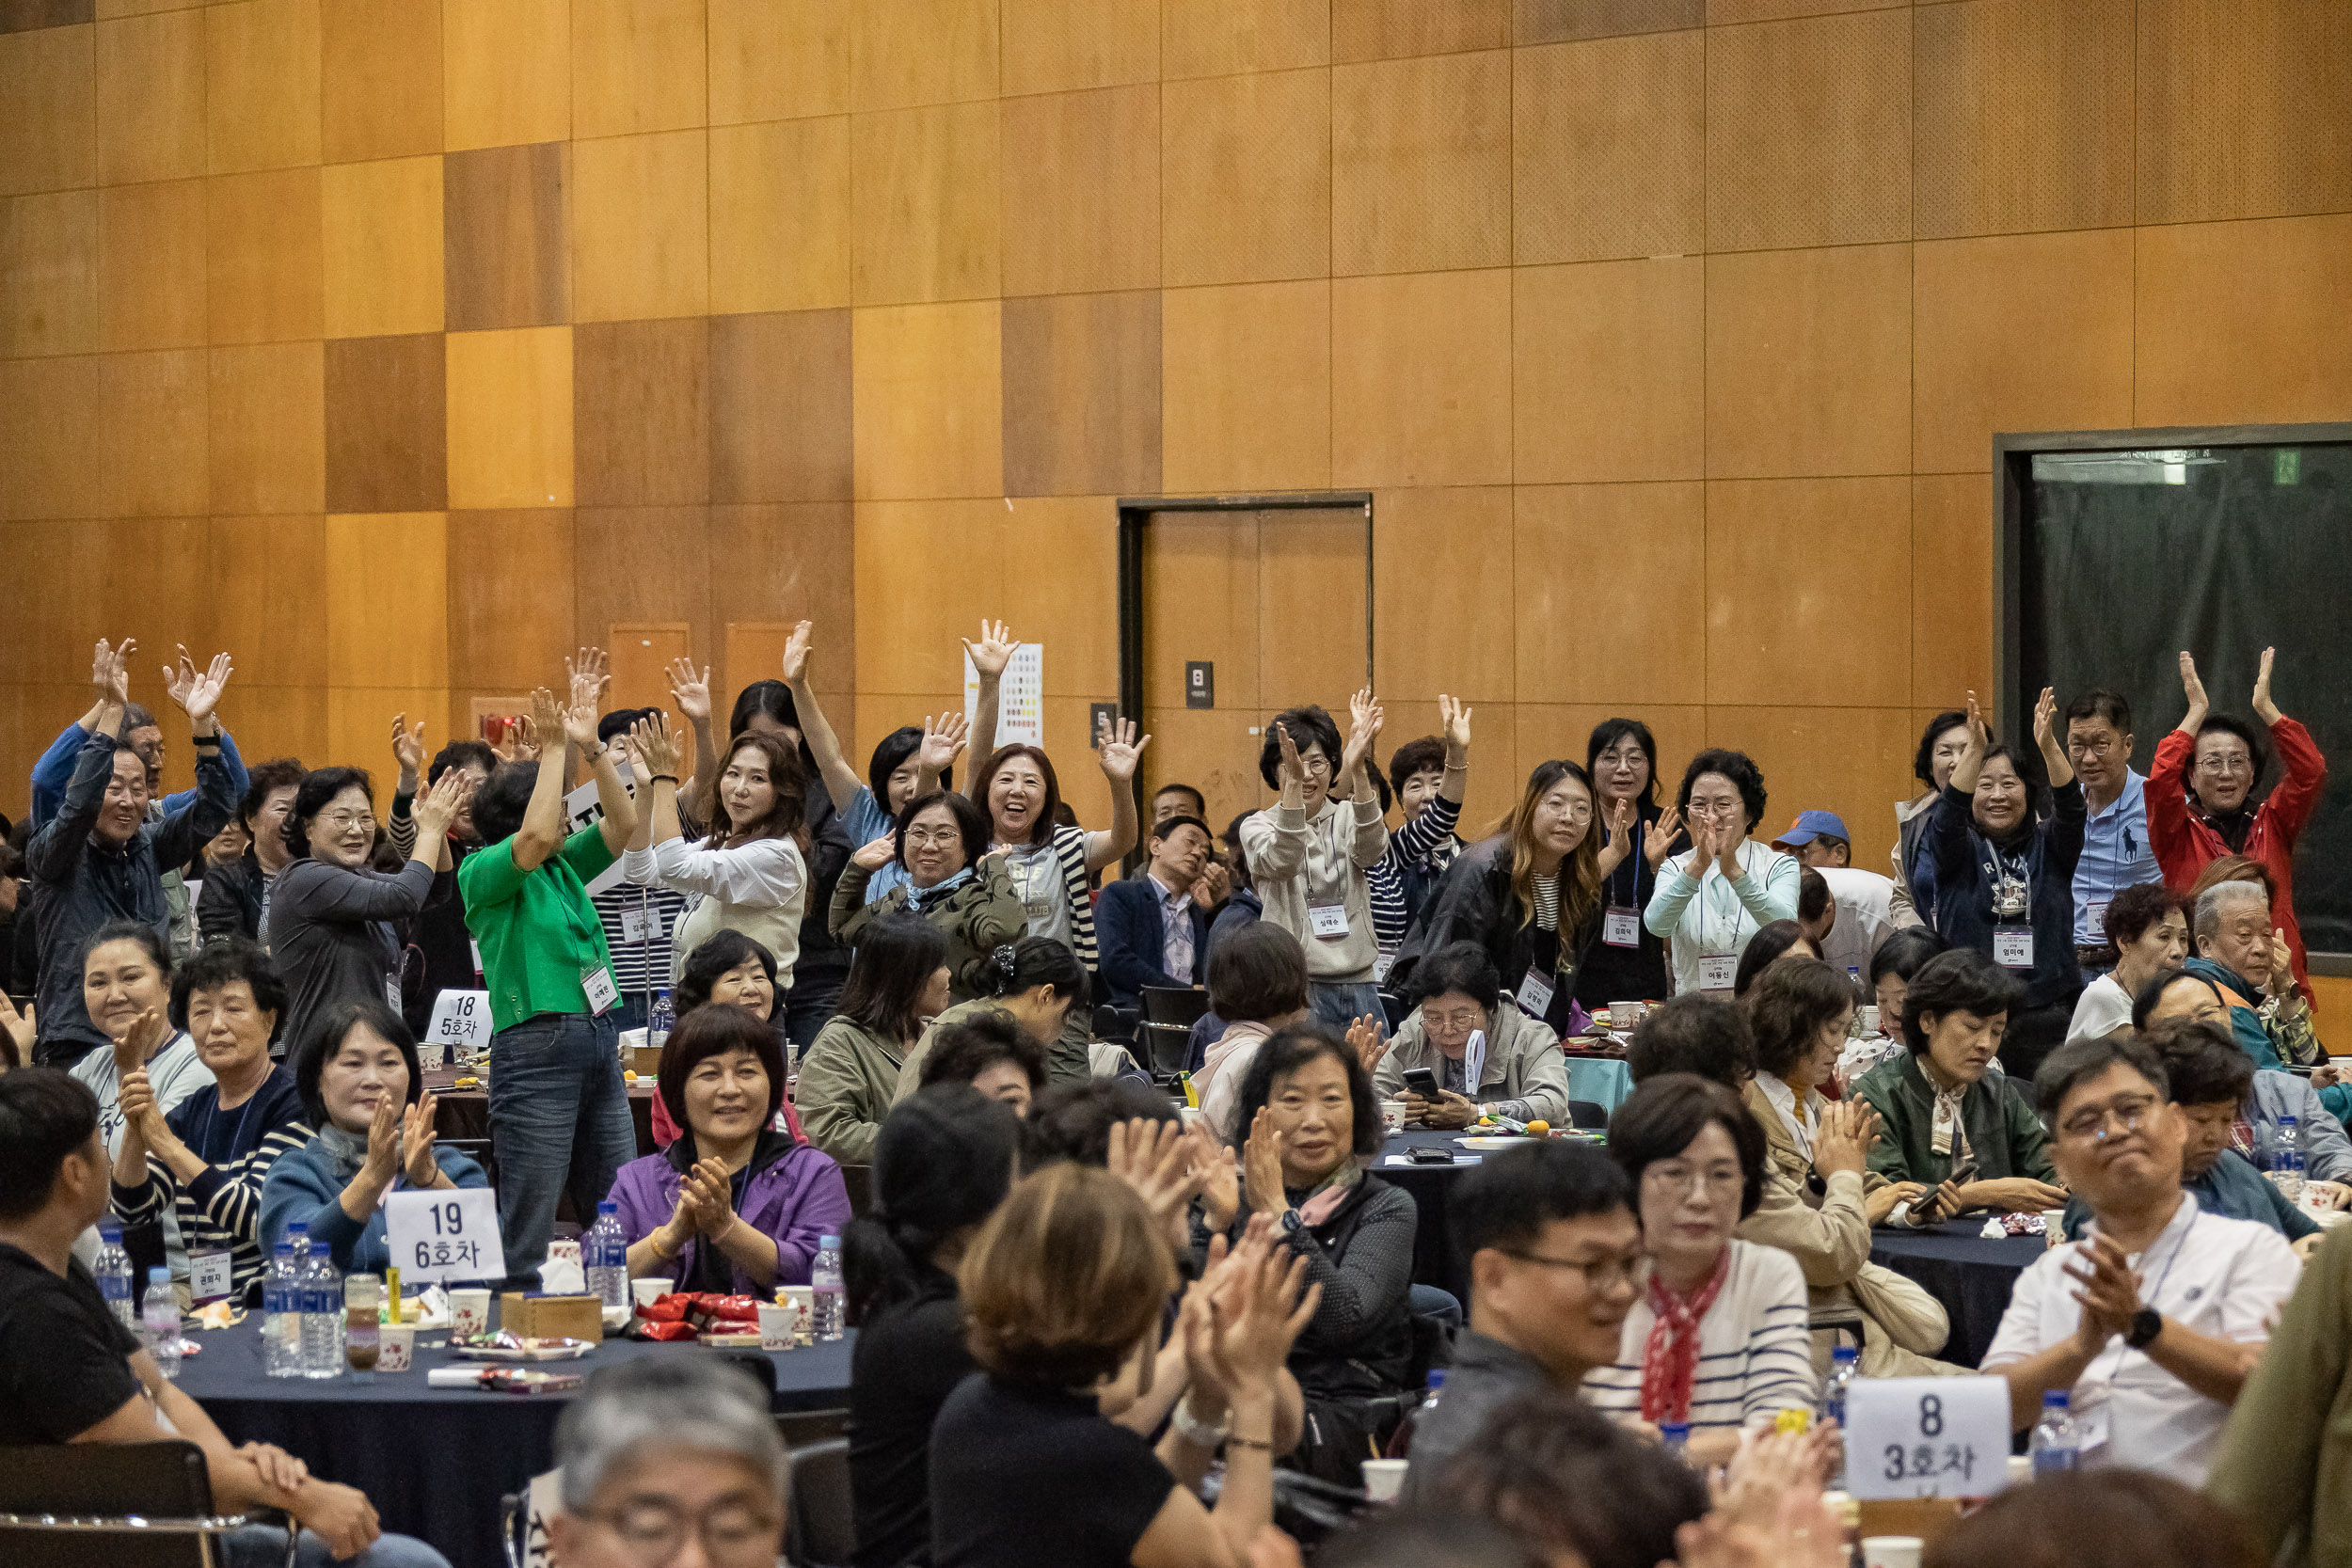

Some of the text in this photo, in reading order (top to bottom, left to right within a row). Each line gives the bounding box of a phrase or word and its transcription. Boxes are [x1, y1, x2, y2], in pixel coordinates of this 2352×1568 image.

[456, 996, 475, 1016] 18
[441, 1018, 477, 1039] 5호차
[429, 1202, 462, 1235] 19
[415, 1241, 480, 1269] 6호차
[1920, 1393, 1944, 1437] 8
[1884, 1443, 1977, 1481] 3호차
